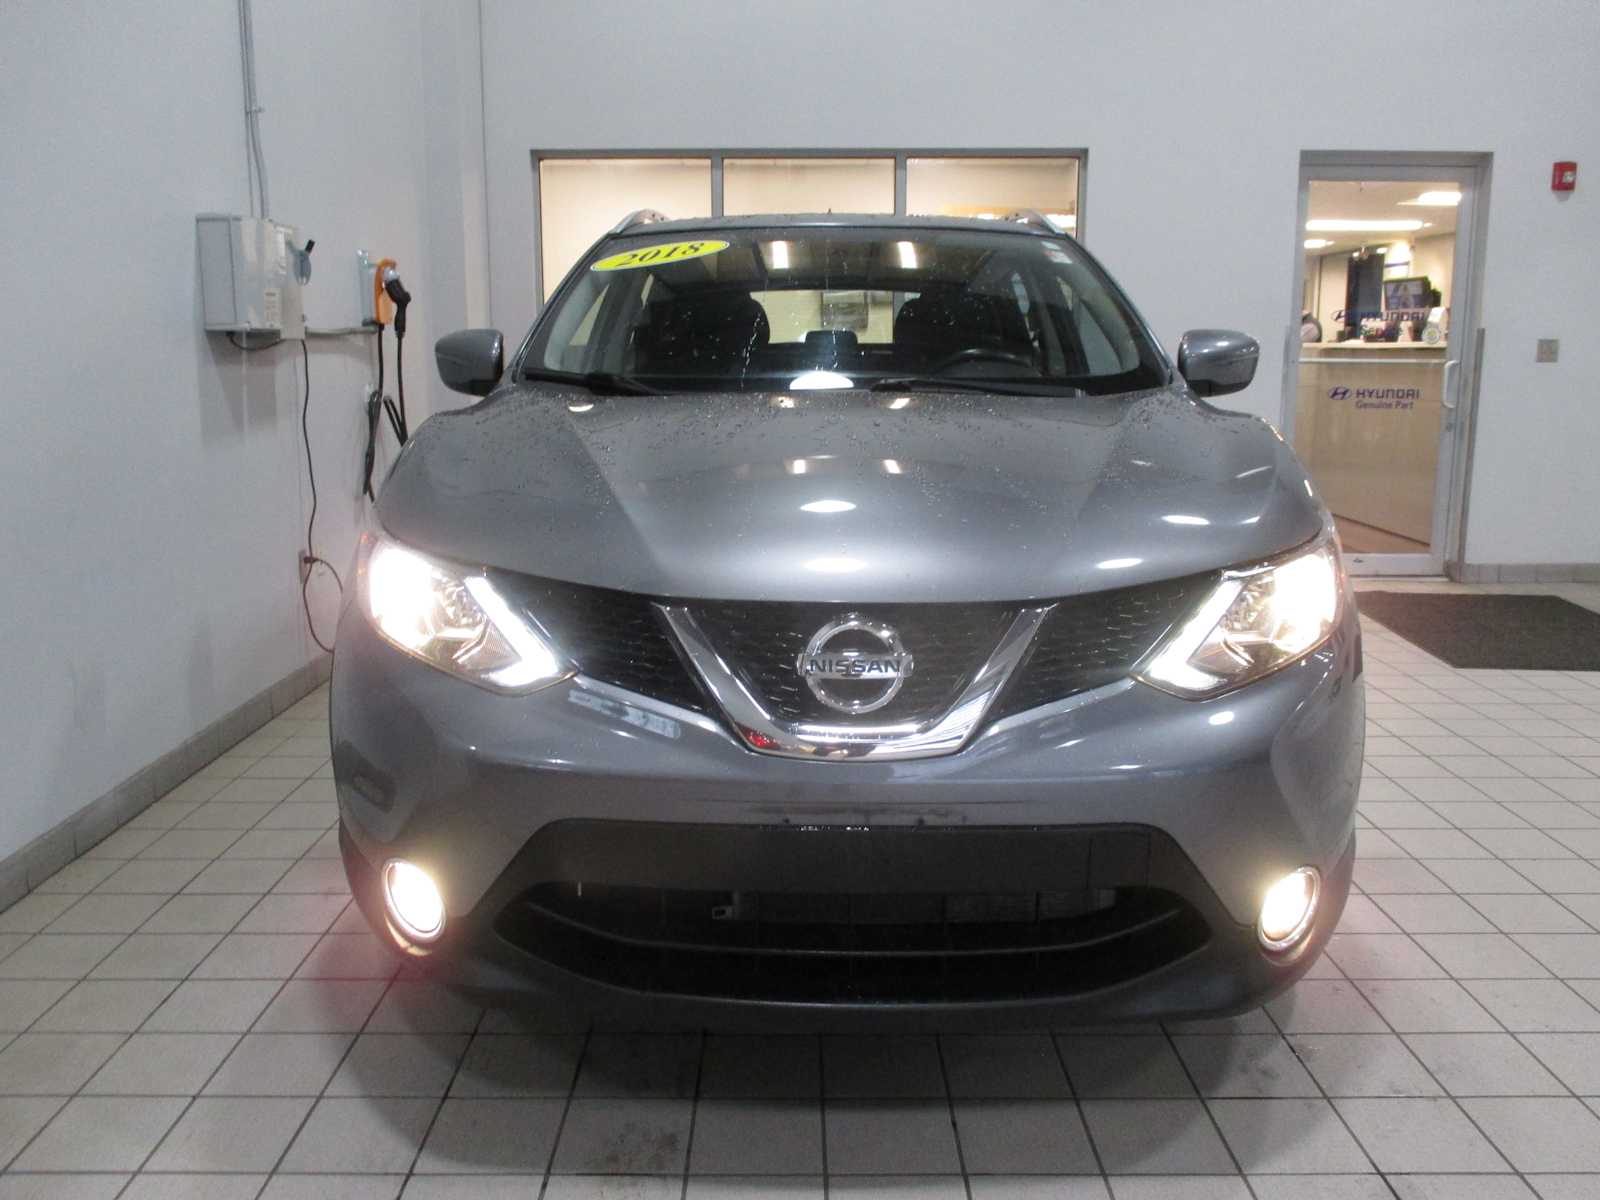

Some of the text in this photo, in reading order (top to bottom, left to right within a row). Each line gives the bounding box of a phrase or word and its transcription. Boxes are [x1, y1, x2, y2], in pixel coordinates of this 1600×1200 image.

[615, 242, 705, 267] 2018
[1356, 388, 1420, 399] HYUNDAI
[807, 659, 900, 673] NISSAN
